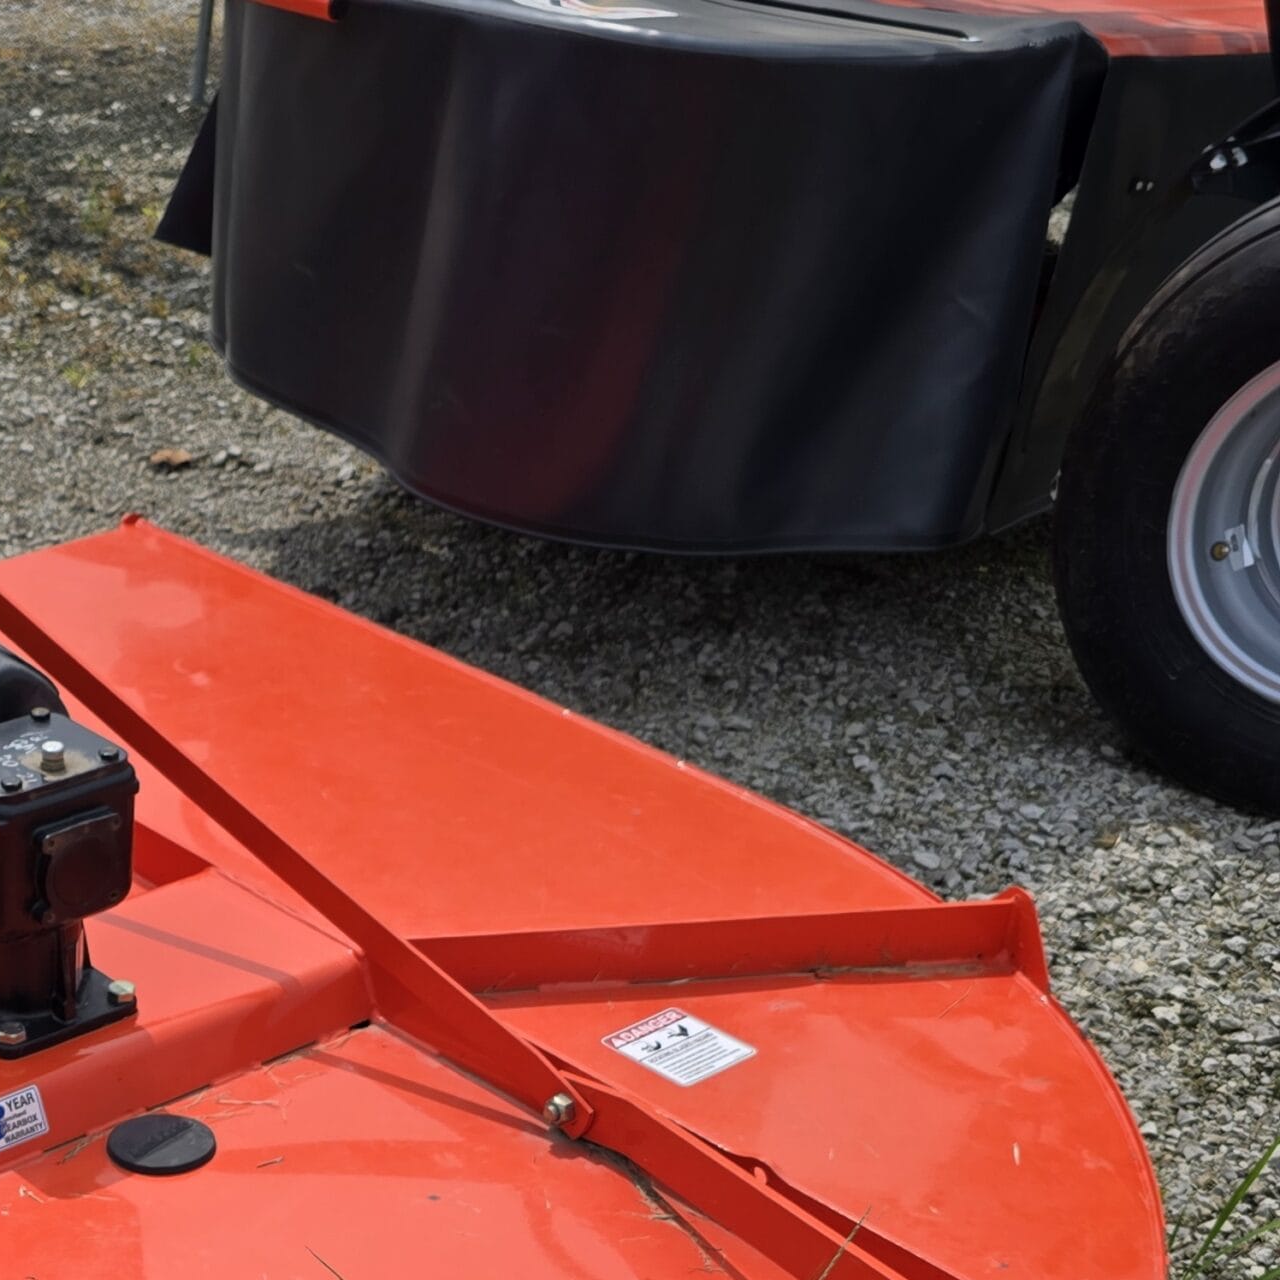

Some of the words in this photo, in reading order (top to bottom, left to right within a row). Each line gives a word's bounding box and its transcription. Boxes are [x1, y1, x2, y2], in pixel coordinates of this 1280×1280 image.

[619, 1009, 682, 1042] DANGER
[5, 1092, 36, 1112] YEAR
[4, 1122, 43, 1144] WARRANTY
